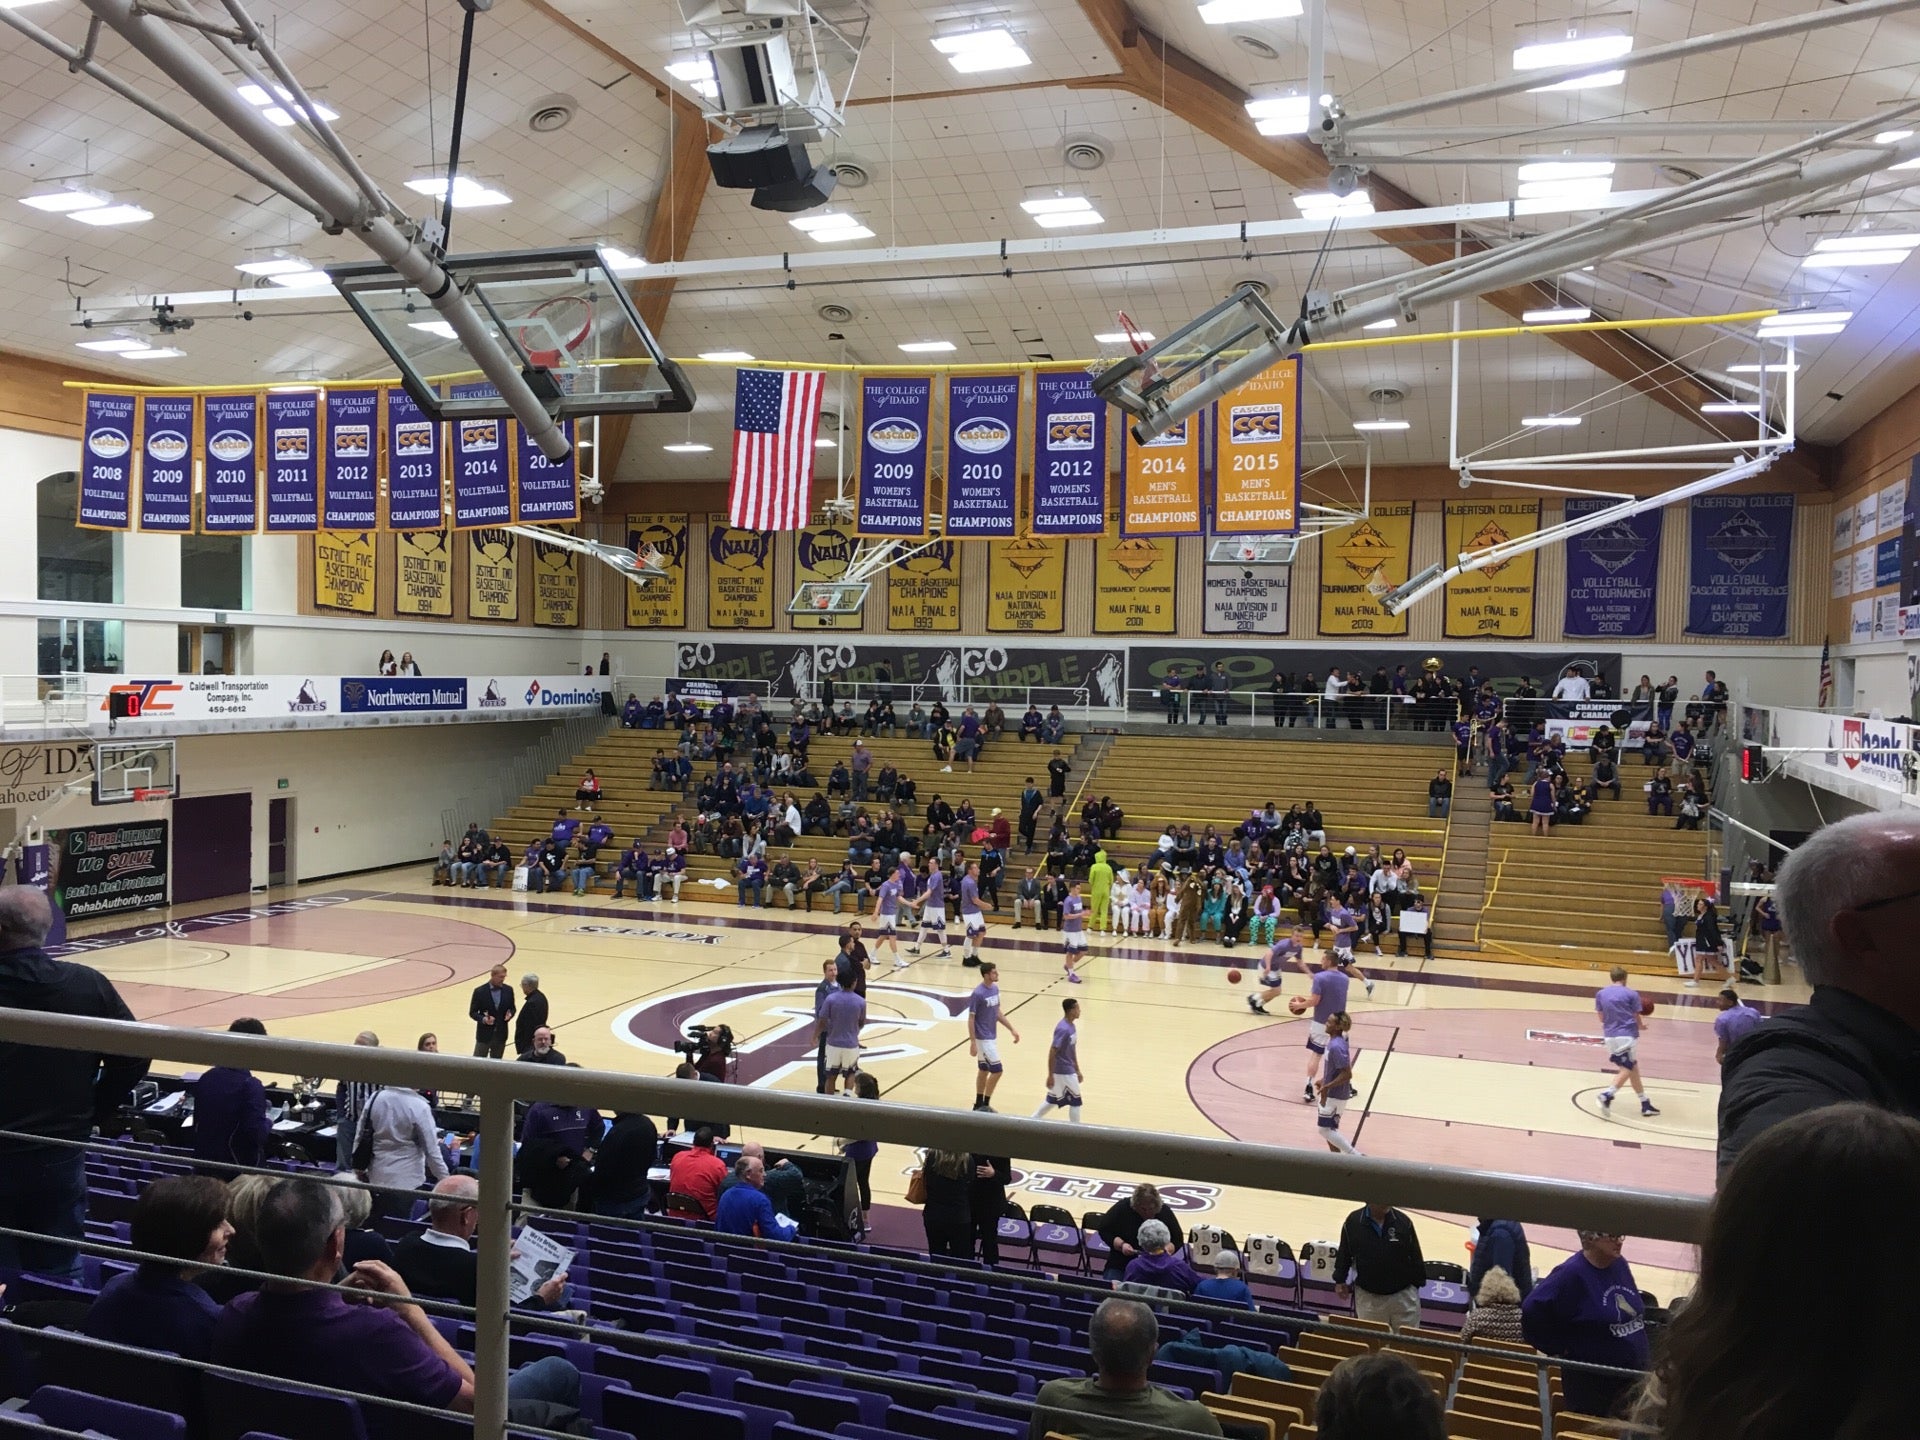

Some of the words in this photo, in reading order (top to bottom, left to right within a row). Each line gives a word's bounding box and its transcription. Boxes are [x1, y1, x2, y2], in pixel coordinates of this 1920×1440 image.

[952, 386, 970, 394] THE
[972, 385, 1016, 394] COLLEGE
[1040, 382, 1058, 390] THE
[330, 398, 342, 406] THE
[344, 396, 375, 406] COLLEGE
[889, 396, 919, 404] IDAHO
[977, 395, 1008, 404] IDAHO
[102, 402, 133, 411] COLLEGE
[221, 403, 254, 411] COLLEGE
[282, 401, 315, 409] COLLEGE
[348, 406, 370, 414] IDAHO
[1232, 405, 1281, 413] CASCADE
[105, 410, 127, 418] IDAHO
[164, 411, 186, 420] IDAHO
[225, 411, 248, 419] IDAHO
[286, 409, 309, 417] IDAHO
[464, 460, 497, 475] 2014
[1142, 457, 1186, 474] 2014
[1233, 454, 1278, 471] 2015
[92, 466, 122, 480] 2008
[337, 467, 368, 480] 2012
[400, 464, 432, 478] 2013
[874, 464, 913, 479] 2009
[962, 464, 1002, 480] 2010
[1050, 461, 1092, 476] 2012
[152, 470, 183, 483] 2009
[216, 470, 245, 483] 2010
[277, 469, 307, 482] 2011
[522, 480, 570, 490] VOLLEYBALL
[1050, 484, 1090, 494] WOMEN'S
[1149, 482, 1176, 491] MEN'S
[1241, 479, 1270, 489] MEN'S
[84, 489, 124, 499] VOLLEYBALL
[329, 490, 373, 500] VOLLEYBALL
[459, 485, 506, 497] VOLLEYBALL
[873, 487, 911, 495] WOMEN'S
[962, 487, 1000, 497] WOMEN'S
[1225, 490, 1287, 502] BASKETBALL
[145, 494, 188, 503] VOLLEYBALL
[210, 495, 253, 503] VOLLEYBALL
[271, 493, 313, 501] VOLLEYBALL
[1041, 497, 1099, 507] BASKETBALL
[1133, 494, 1192, 505] BASKETBALL
[1693, 496, 1746, 508] ALBERTSON
[1750, 496, 1793, 506] COLLEGE
[521, 501, 574, 512] CHAMPIONS
[865, 498, 918, 508] BASKETBALL
[953, 499, 1008, 509] BASKETBALL
[82, 508, 126, 520] CHAMPIONS
[457, 506, 509, 519] CHAMPIONS
[1375, 507, 1411, 516] COLLEGE
[1447, 505, 1495, 515] ALBERTSON
[1499, 503, 1538, 514] COLLEGE
[143, 513, 190, 524] CHAMPIONS
[207, 514, 254, 524] CHAMPIONS
[269, 513, 316, 523] CHAMPIONS
[326, 512, 375, 521] CHAMPIONS
[391, 510, 439, 520] CHAMPIONS
[1036, 514, 1102, 525] CHAMPIONS
[1129, 511, 1196, 524] CHAMPIONS
[1220, 509, 1292, 522] CHAMPIONS
[861, 515, 922, 527] CHAMPIONS
[949, 517, 1012, 528] CHAMPIONS
[722, 539, 759, 559] NAIA
[811, 545, 847, 563] NAIA
[403, 556, 430, 570] DISTRICT
[434, 560, 446, 572] TWO
[404, 570, 445, 585] BASKETBALL
[718, 577, 747, 585] DISTRICT
[750, 577, 764, 585] TWO
[1583, 577, 1641, 587] VOLLEYBALL
[1710, 575, 1768, 585] VOLLEYBALL
[476, 579, 511, 592] BASKETBALL
[1241, 579, 1287, 588] BASKETBALL
[407, 584, 442, 598] CHAMPIONS
[540, 586, 576, 599] BASKETBALL
[718, 585, 762, 593] BASKETBALL
[901, 588, 947, 598] CHAMPIONS
[1226, 588, 1267, 596] CHAMPIONS
[1322, 585, 1364, 593] TOURNAMENT
[1450, 586, 1491, 594] TOURNAMENT
[1494, 586, 1530, 594] CHAMPIONS
[1571, 589, 1589, 598] CCC
[1593, 588, 1652, 598] TOURNAMENT
[1691, 585, 1728, 595] CASCADE
[1732, 585, 1788, 595] CONFERENCE
[479, 591, 508, 604] CHAMPIONS
[723, 594, 757, 602] CHAMPIONS
[995, 591, 1014, 599] NAIA
[892, 606, 914, 616] NAIA
[922, 605, 946, 616] FINAL
[1008, 601, 1042, 610] NATIONAL
[1109, 605, 1127, 613] NAIA
[1129, 605, 1152, 613] FINAL
[1215, 603, 1233, 611] NAIA
[1237, 603, 1268, 611] DIVISION
[1335, 606, 1354, 615] NAIA
[1357, 606, 1380, 615] FINAL
[739, 609, 757, 617] FINAL
[1005, 610, 1045, 620] CHAMPIONS
[1461, 607, 1480, 616] NAIA
[1484, 606, 1506, 616] FINAL
[1224, 612, 1267, 621] RUNNER-UP
[1591, 612, 1630, 621] CHAMPIONS
[1712, 612, 1762, 622] CHAMPIONS
[1478, 620, 1500, 629] 2004
[1599, 622, 1623, 632] 2005
[679, 642, 715, 671] GO
[817, 645, 856, 673] GO
[964, 646, 1008, 676] GO
[966, 655, 1081, 700] PURPLE
[190, 682, 219, 691] Caldwell
[222, 681, 269, 691] Transportation
[207, 692, 239, 702] Company,
[241, 693, 253, 702] Inc.
[368, 689, 430, 706] Northwestern
[542, 688, 600, 705] Domino's
[128, 695, 138, 715] 0
[288, 701, 326, 712] YOTES
[478, 697, 506, 707] YOTES
[1862, 722, 1901, 770] bank
[1861, 765, 1886, 781] serving
[107, 851, 153, 870] SOLVE
[66, 885, 90, 899] Back
[99, 882, 121, 894] Neck
[121, 873, 165, 891] Problems!
[71, 893, 162, 914] RehabAuthority.com
[197, 896, 349, 925] IDAHO
[1610, 1315, 1644, 1337] YOTES
